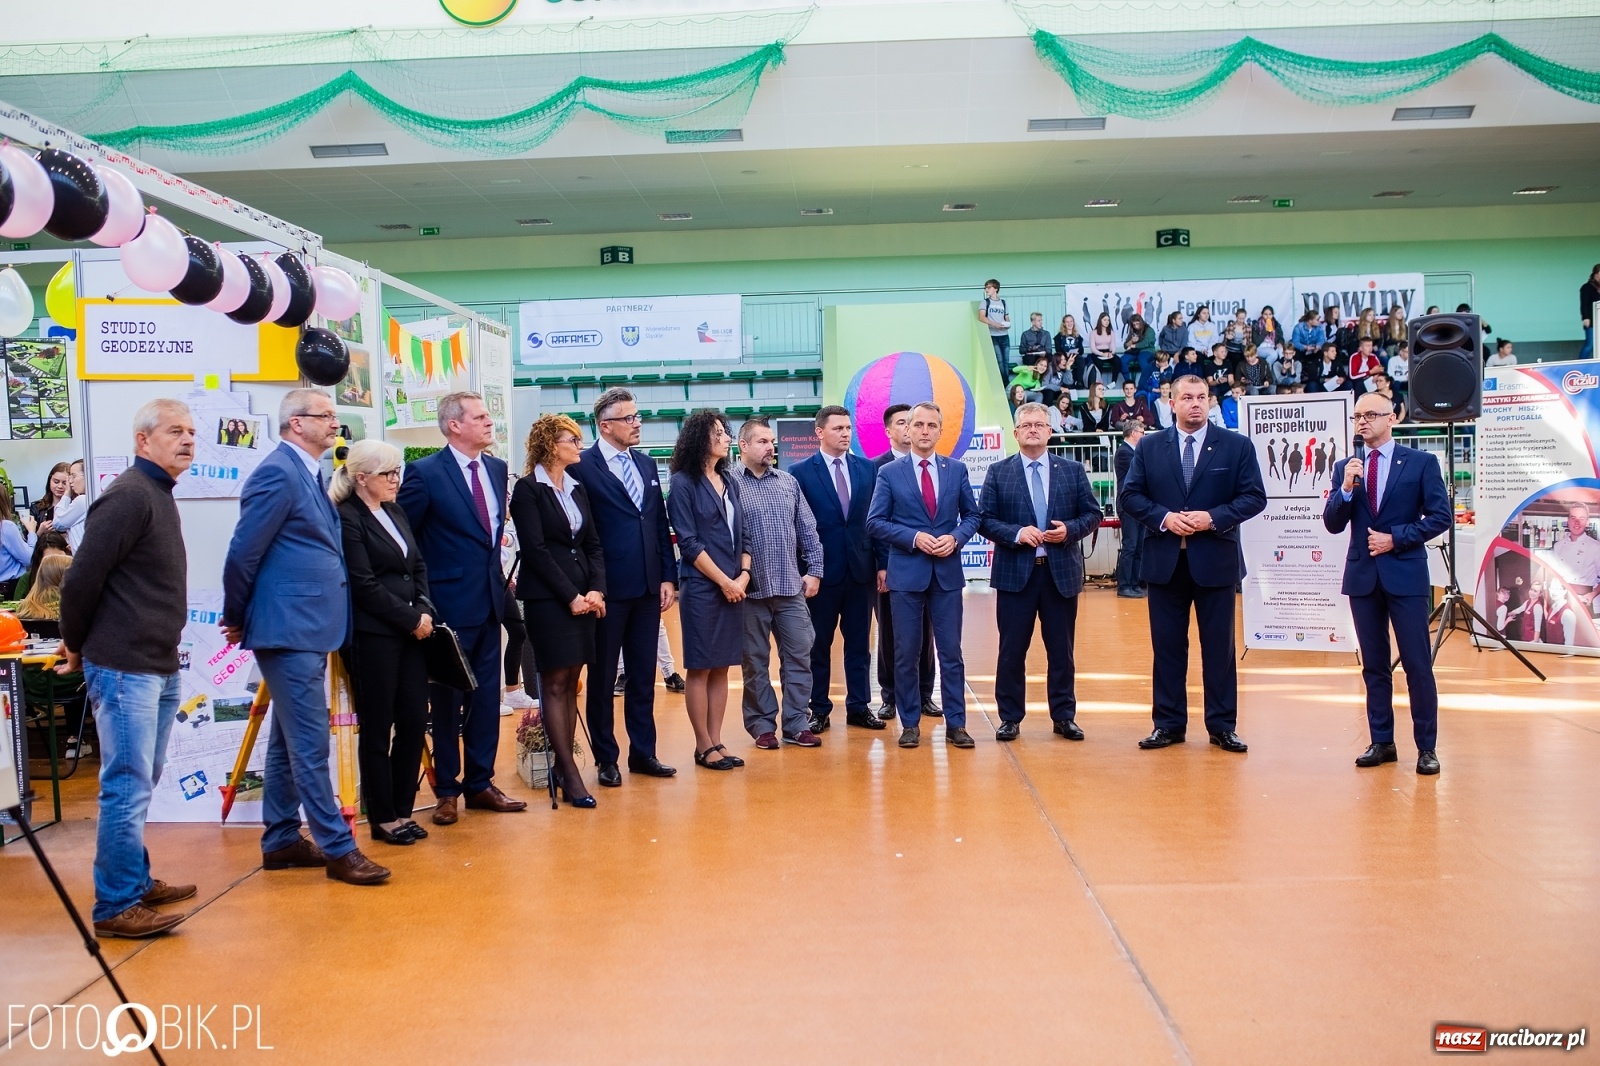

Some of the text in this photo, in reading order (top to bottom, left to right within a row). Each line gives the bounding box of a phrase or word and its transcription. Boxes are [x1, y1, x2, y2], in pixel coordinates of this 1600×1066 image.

[1160, 235, 1173, 245] C
[1179, 234, 1188, 245] C
[603, 252, 612, 263] B
[618, 251, 630, 262] B
[606, 304, 654, 313] PARTNERZY
[101, 321, 156, 335] STUDIO
[551, 333, 597, 345] RAFAMET
[101, 340, 194, 353] GEODEZYJNE
[1482, 396, 1511, 404] RAKTYKI
[1254, 406, 1305, 420] Festiwal
[1496, 414, 1543, 422] PORTUGALIA
[1255, 420, 1327, 435] perspektyw
[977, 455, 999, 463] portal
[1290, 505, 1311, 513] edycja
